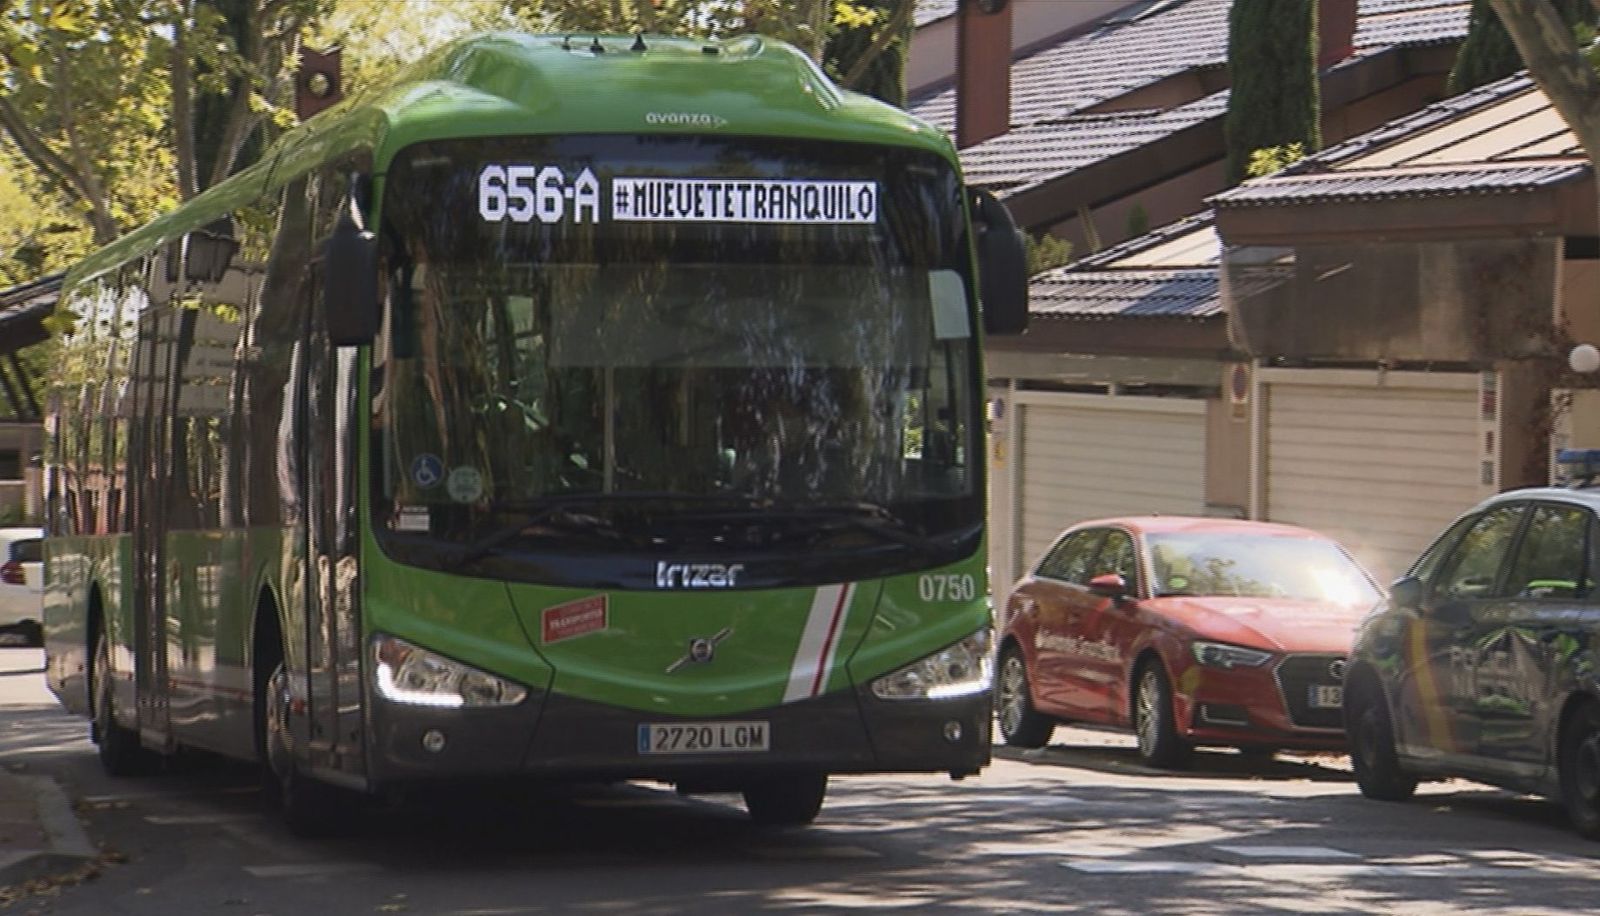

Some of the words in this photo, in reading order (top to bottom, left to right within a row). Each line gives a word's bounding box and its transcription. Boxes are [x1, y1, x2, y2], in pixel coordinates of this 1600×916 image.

[646, 112, 711, 125] avanza
[478, 165, 600, 224] 656-A
[614, 181, 876, 220] #MUEVETETRANQUILO
[918, 574, 975, 602] 0750
[655, 726, 713, 750] 2720
[719, 725, 764, 749] LGM
